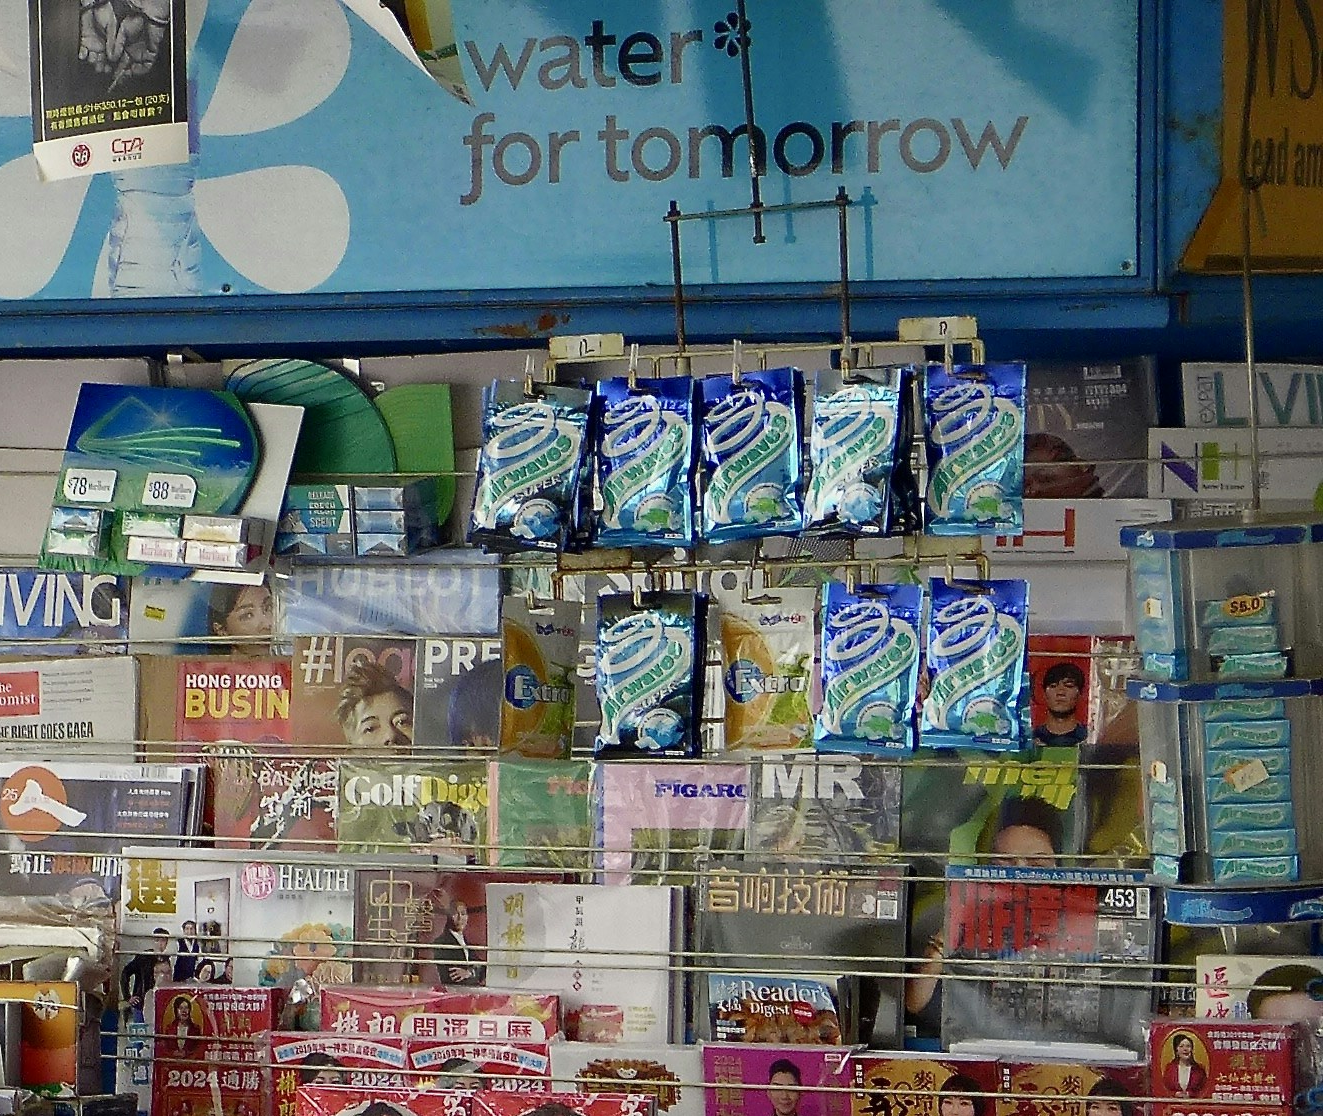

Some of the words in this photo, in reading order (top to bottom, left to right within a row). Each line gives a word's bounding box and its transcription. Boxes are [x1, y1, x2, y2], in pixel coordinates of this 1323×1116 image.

[463, 20, 702, 93] water
[459, 113, 581, 206] for
[604, 109, 1028, 183] tomorrow
[933, 412, 1014, 511] Airwaves
[68, 476, 88, 496] $78
[149, 481, 170, 500] $88
[186, 674, 232, 689] HONG
[236, 674, 282, 689] KONG
[734, 667, 808, 698] Extra
[826, 634, 912, 719] Airwaves
[931, 629, 1014, 712] Airwaves
[185, 688, 290, 719] BUSIN
[12, 724, 38, 739] RIGHT
[41, 723, 64, 739] GOES
[67, 721, 94, 738] GAGA
[762, 754, 864, 800] MR
[2, 788, 18, 801] 25
[279, 864, 350, 892] HEALTH
[1105, 888, 1135, 908] 453
[740, 979, 831, 1005] Reader's
[750, 1001, 791, 1018] Digest
[350, 1071, 405, 1087] 2024
[491, 1077, 546, 1093] 2024
